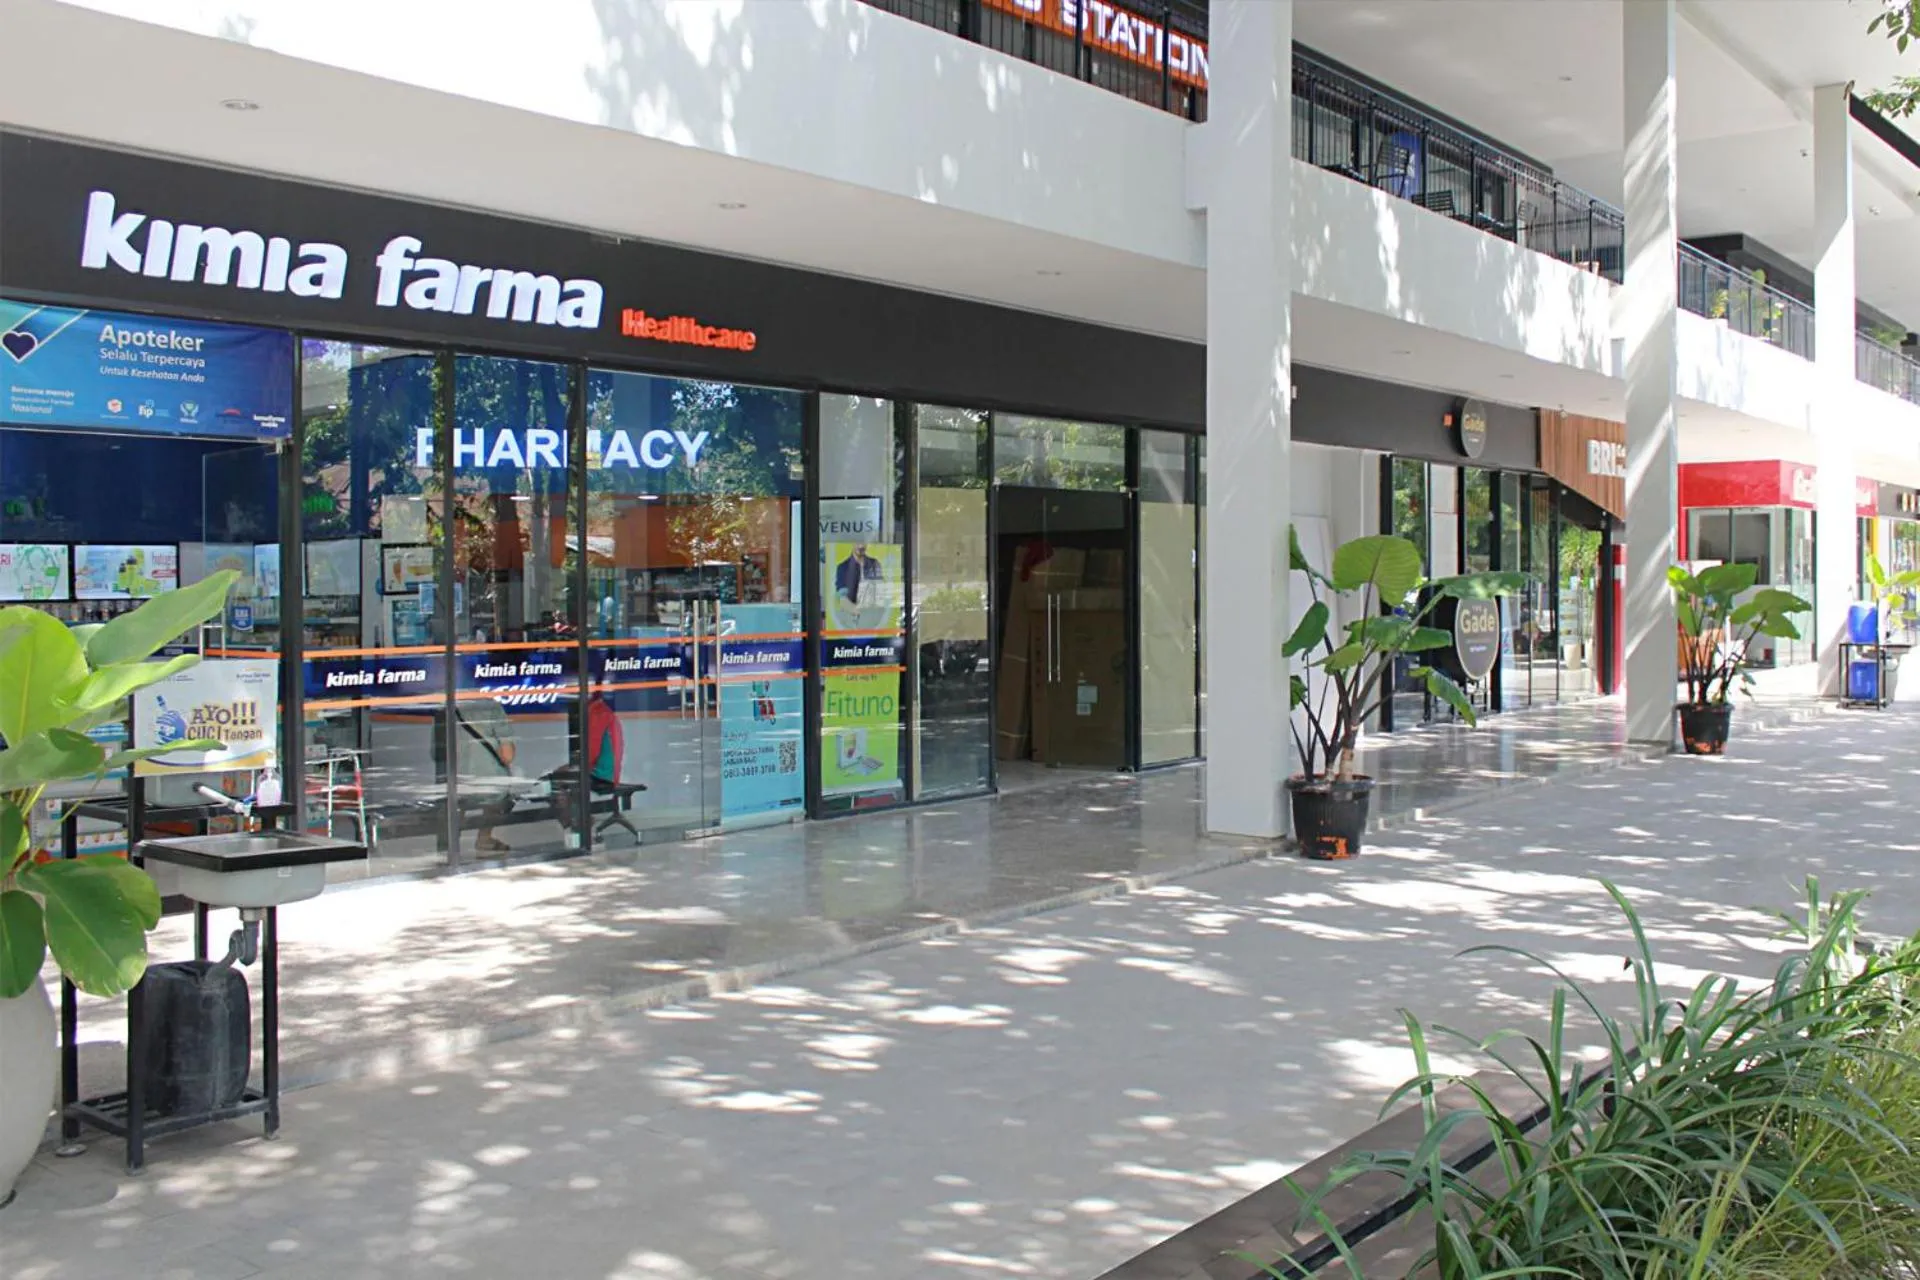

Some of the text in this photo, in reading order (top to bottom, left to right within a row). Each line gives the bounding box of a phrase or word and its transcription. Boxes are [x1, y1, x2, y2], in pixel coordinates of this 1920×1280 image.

[81, 191, 603, 329] kimia farma
[99, 324, 205, 352] Apoteker
[622, 308, 756, 351] Healthcare
[99, 347, 206, 369] Selalu Terpercaya
[100, 365, 206, 383] Untuk Kesehatan Anda
[1461, 607, 1496, 634] Gade
[722, 650, 791, 665] kimia farma
[834, 645, 894, 659] kimia farma
[474, 661, 563, 678] kimia farma
[604, 655, 681, 671] kimia farma
[326, 668, 427, 687] kimia farma
[190, 702, 257, 725] AYO!!!
[827, 690, 894, 718] Fituno
[187, 725, 222, 741] CUCI
